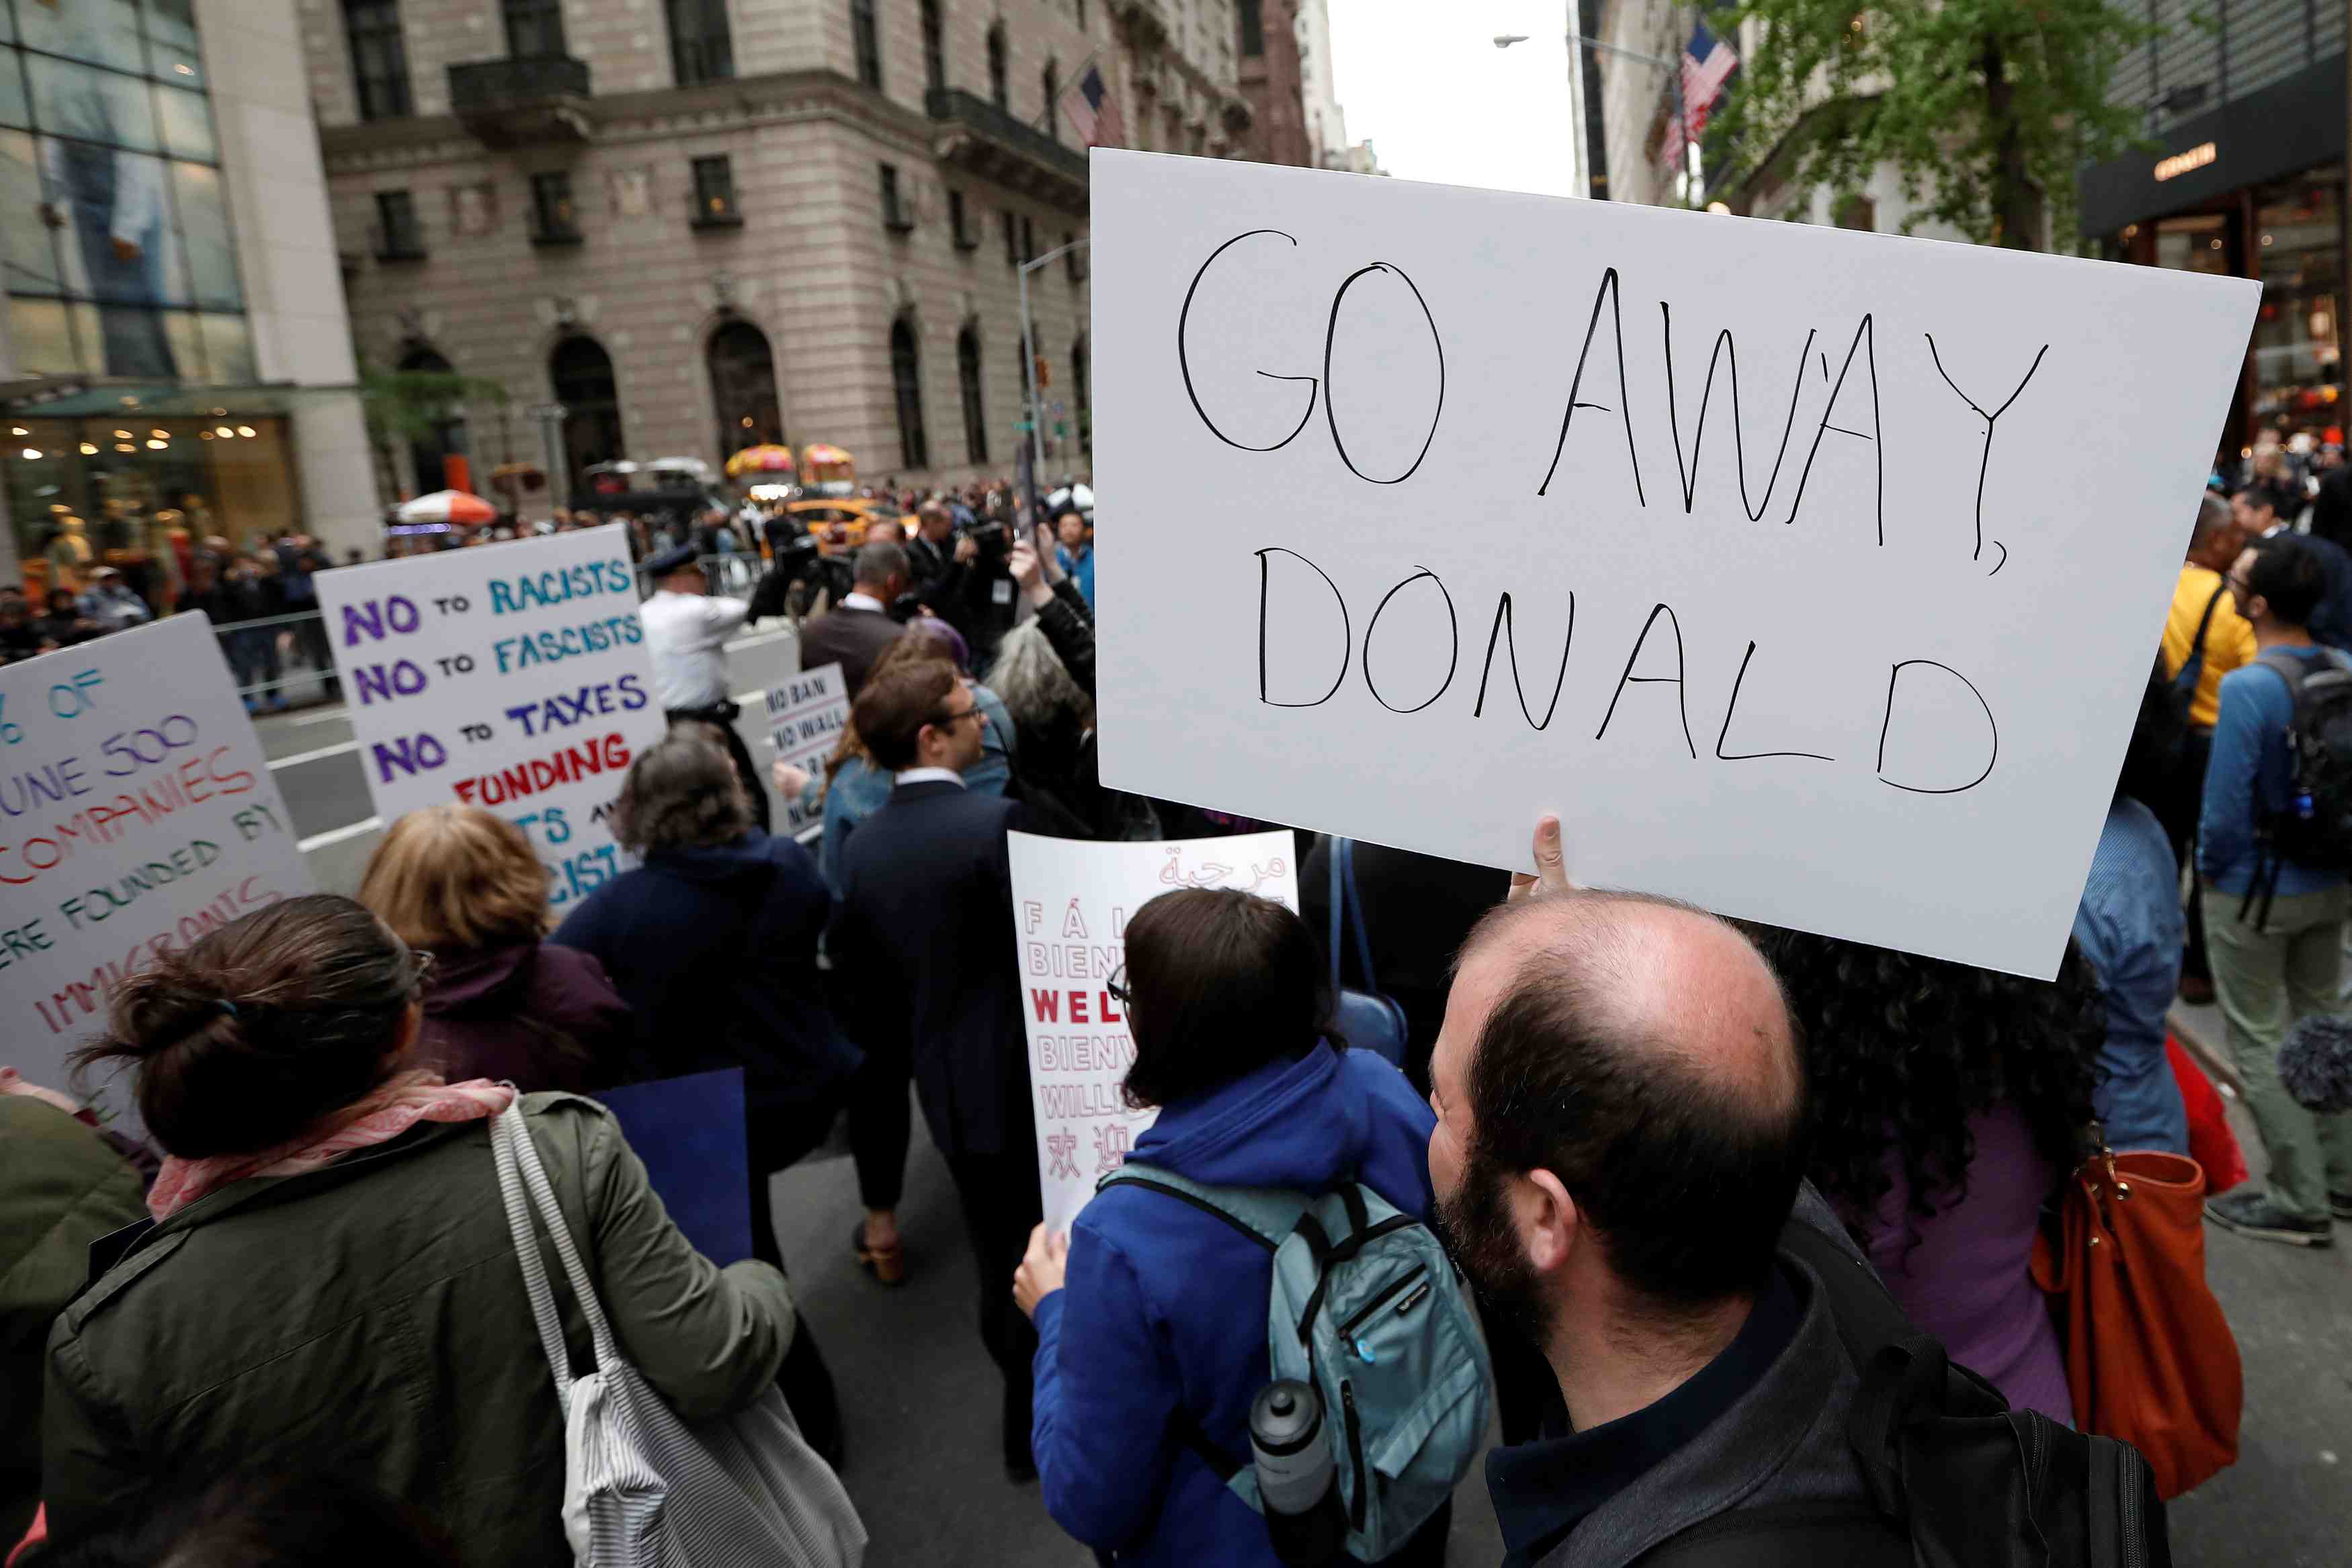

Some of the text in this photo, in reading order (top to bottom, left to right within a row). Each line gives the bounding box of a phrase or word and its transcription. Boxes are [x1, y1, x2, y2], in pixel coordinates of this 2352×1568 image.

[1177, 228, 2049, 576] GO AWAY,
[341, 560, 631, 647] NO TO RACISTS
[48, 668, 105, 718] OF
[352, 615, 643, 705] NO TO FASCISTS
[790, 678, 826, 703] BAN
[1254, 546, 1998, 793] DONALD
[100, 715, 198, 776] 500
[372, 673, 647, 785] NO TO TAXES
[452, 732, 631, 805] FUNDING
[58, 840, 221, 930] FOUNDED
[1032, 988, 1120, 1024] WEL
